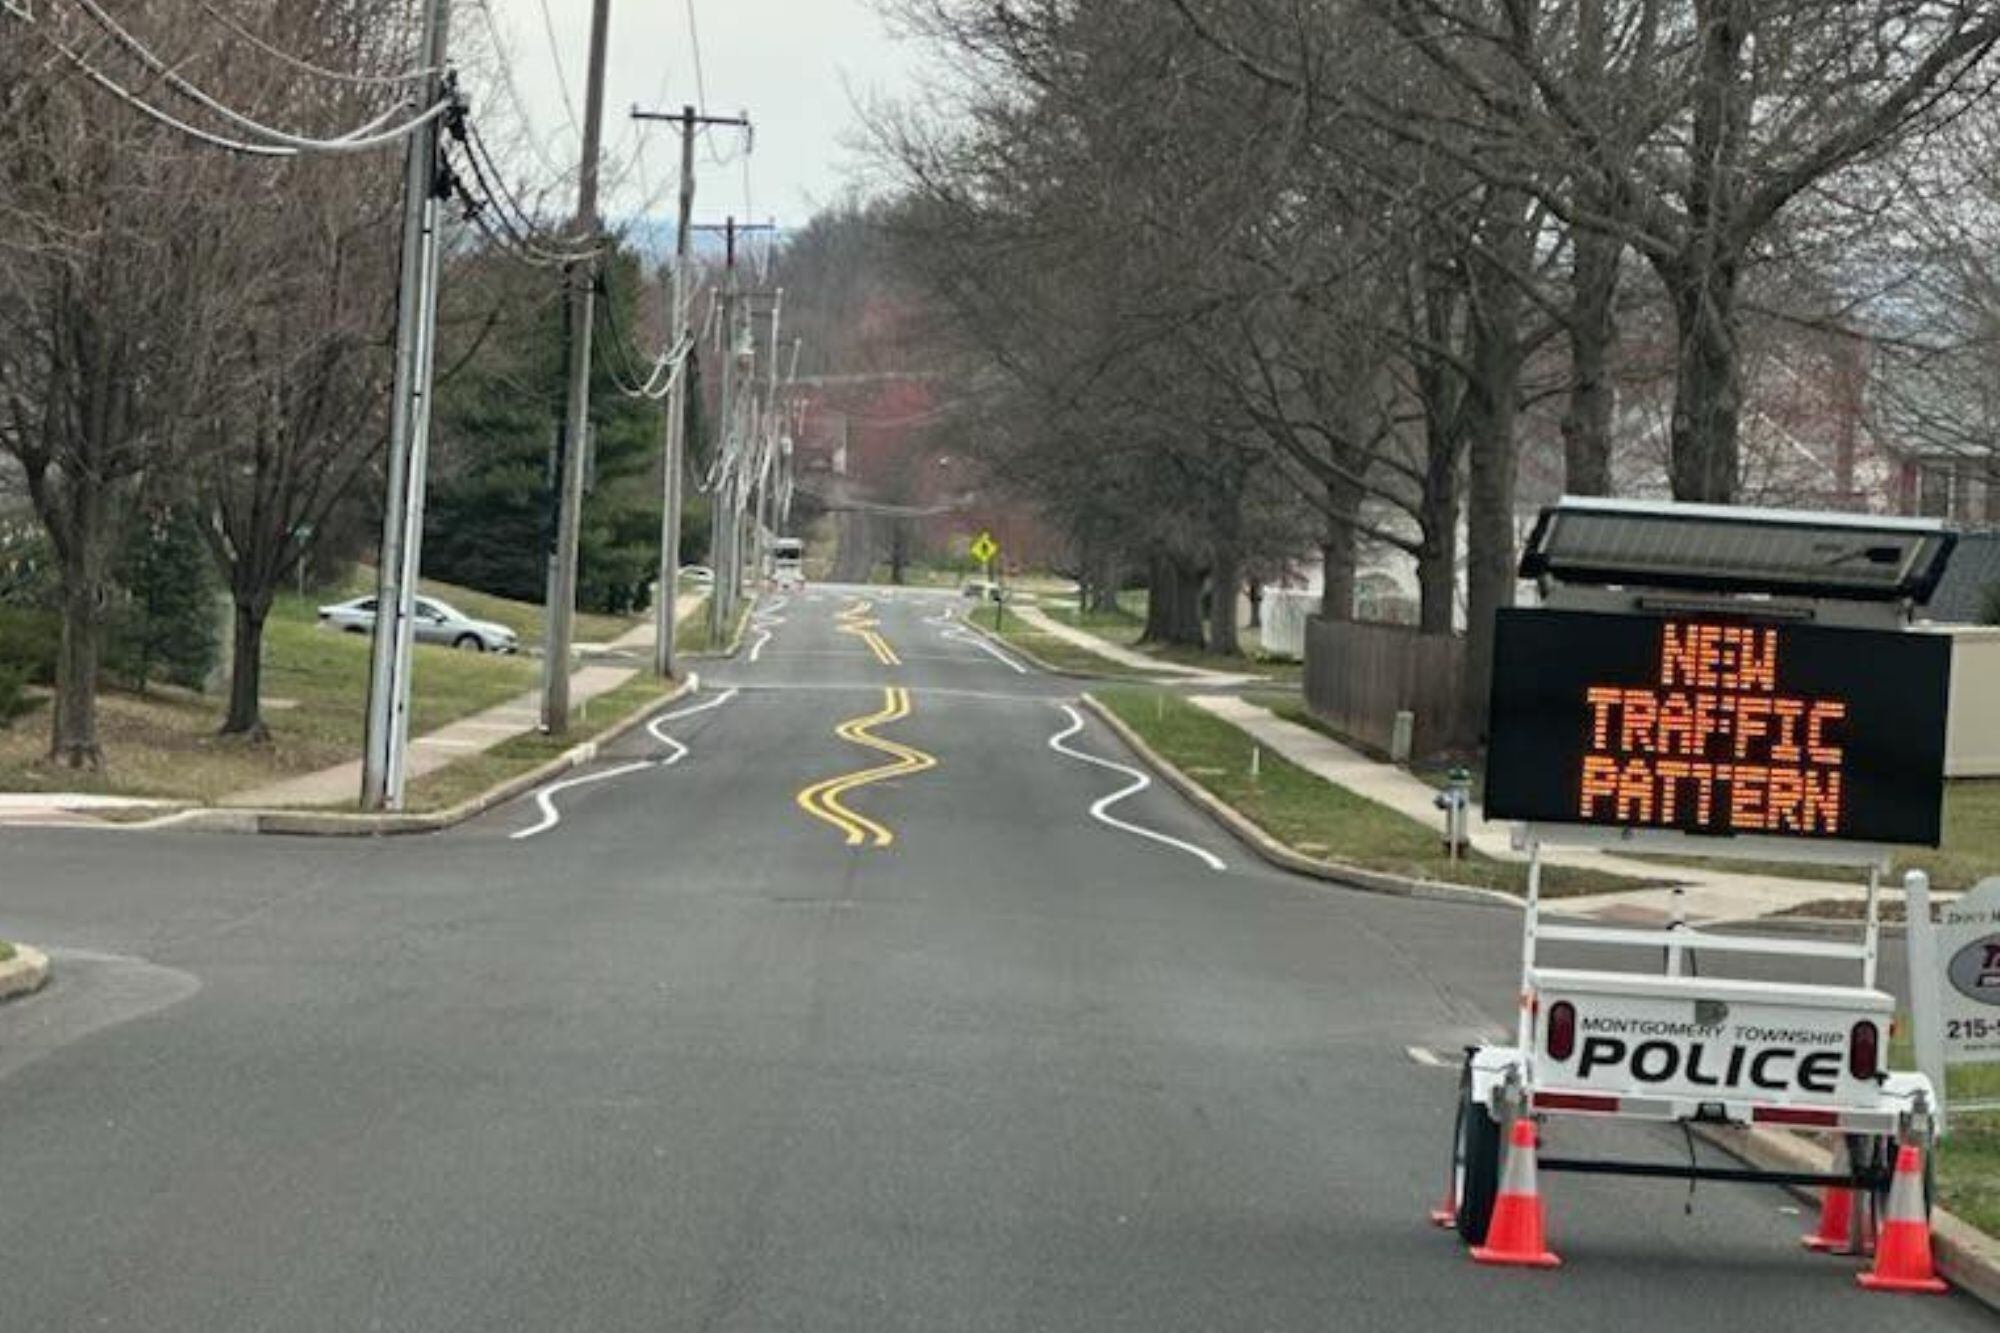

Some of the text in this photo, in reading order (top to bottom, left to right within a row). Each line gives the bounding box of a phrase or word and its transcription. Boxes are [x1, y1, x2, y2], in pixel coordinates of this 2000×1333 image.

[1661, 624, 1777, 690] NEW
[1586, 687, 1845, 764] TRAFFIC
[1580, 757, 1841, 832] PATTERN
[1582, 1018, 1844, 1045] MONTGOMERY TOWNSHIP
[1947, 1018, 2000, 1039] 215-
[1576, 1037, 1843, 1093] POLICE
